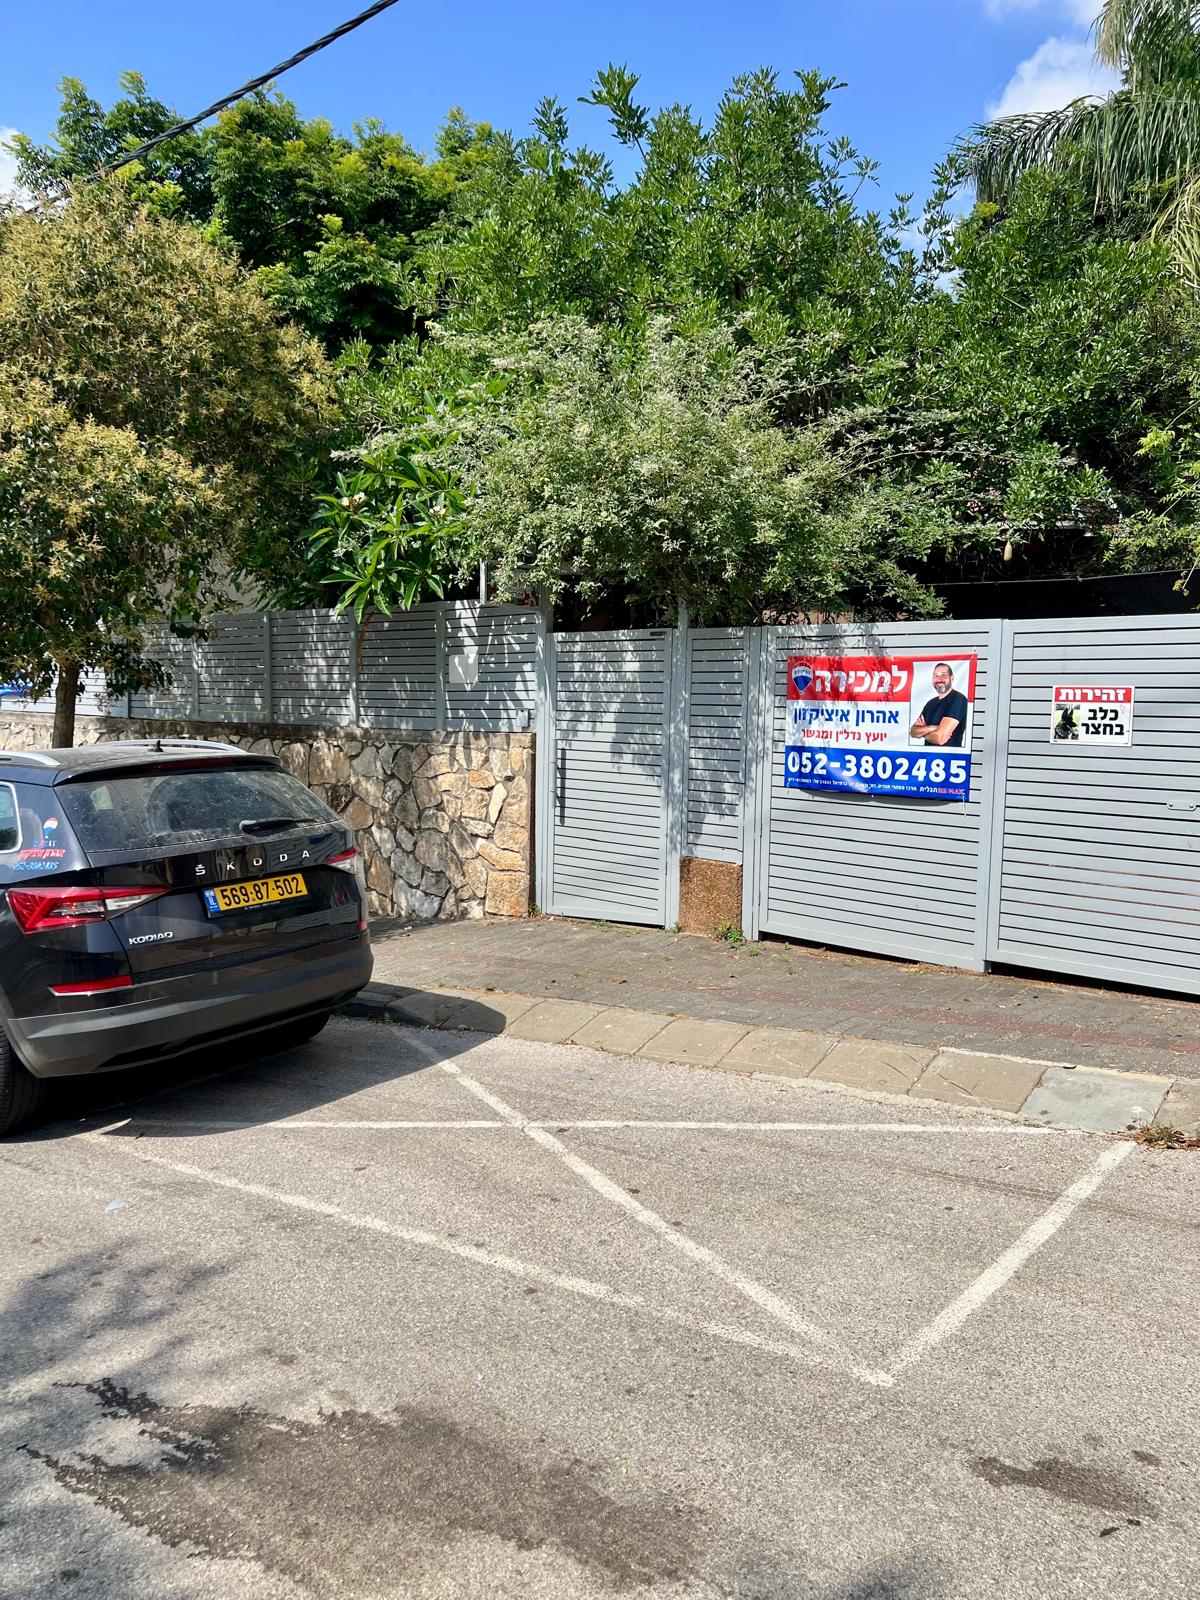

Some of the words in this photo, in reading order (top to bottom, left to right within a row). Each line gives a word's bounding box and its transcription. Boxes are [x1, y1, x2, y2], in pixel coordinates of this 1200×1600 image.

[815, 665, 908, 693] למכירה
[1059, 688, 1126, 701] זהירות
[794, 708, 850, 725] איציקזון
[855, 709, 899, 726] אהרון
[1088, 707, 1119, 721] כלב
[802, 729, 832, 740] ומגשר
[1081, 723, 1124, 735] בחצר
[865, 732, 887, 744] יועץ
[787, 751, 966, 784] 052-3802485
[195, 850, 310, 876] ŠKODA
